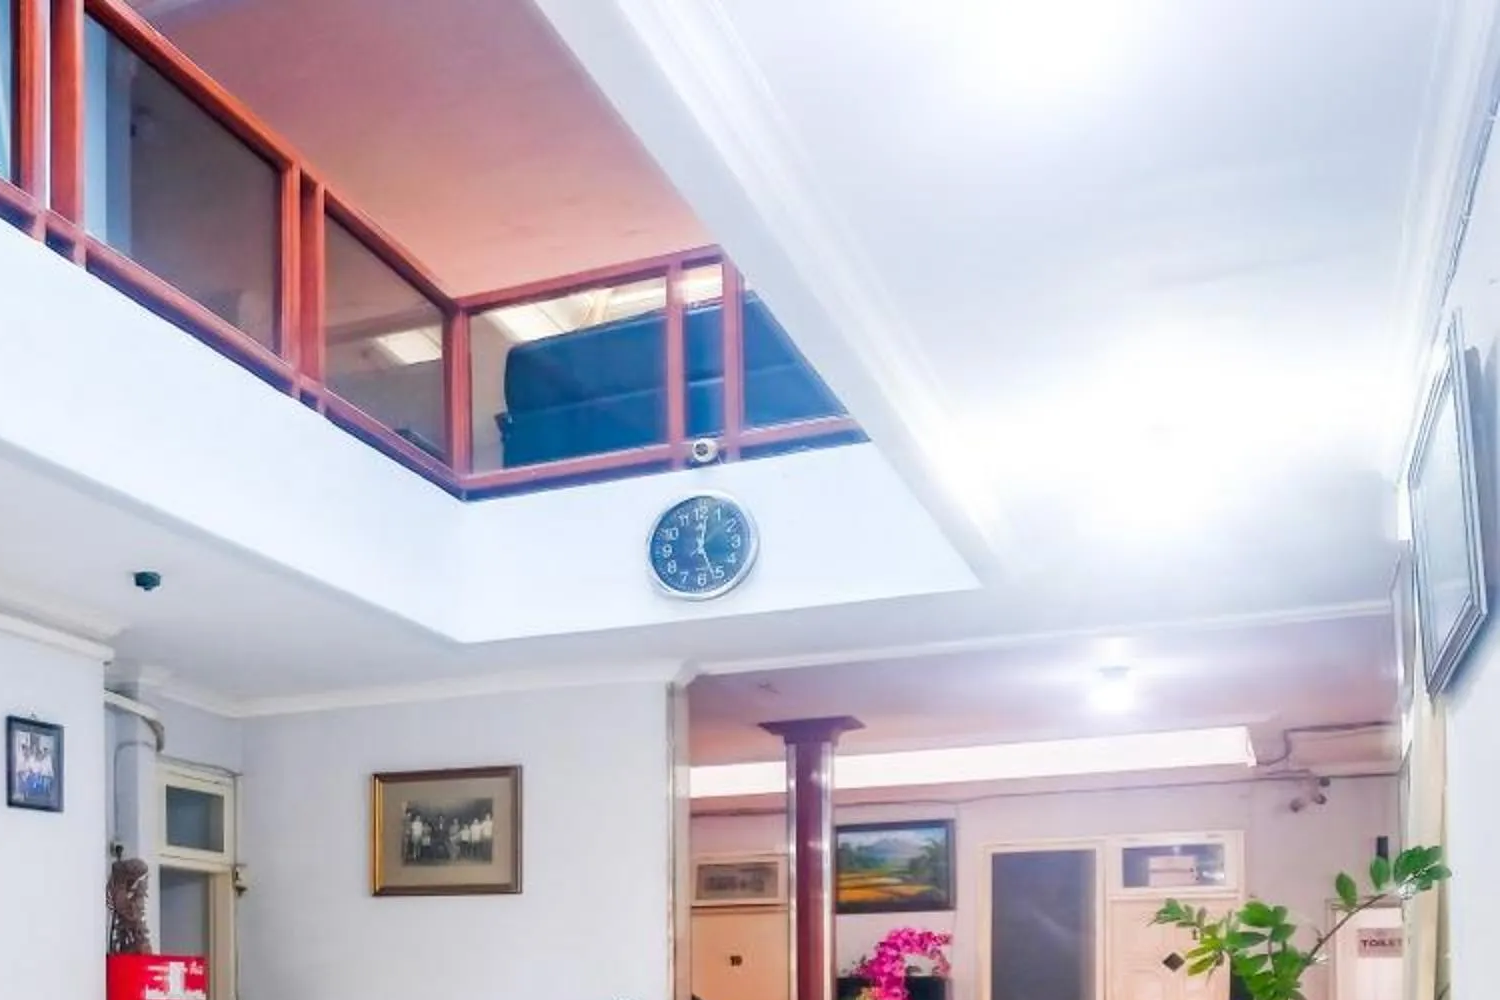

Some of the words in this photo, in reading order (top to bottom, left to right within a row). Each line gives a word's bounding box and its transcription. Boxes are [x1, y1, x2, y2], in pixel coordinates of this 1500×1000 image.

[714, 507, 721, 520] 1
[725, 518, 736, 532] 2
[731, 534, 740, 548] 3
[662, 543, 673, 558] 9
[667, 560, 677, 574] 8
[714, 565, 725, 579] 5
[680, 571, 689, 584] 7
[697, 572, 707, 586] 6
